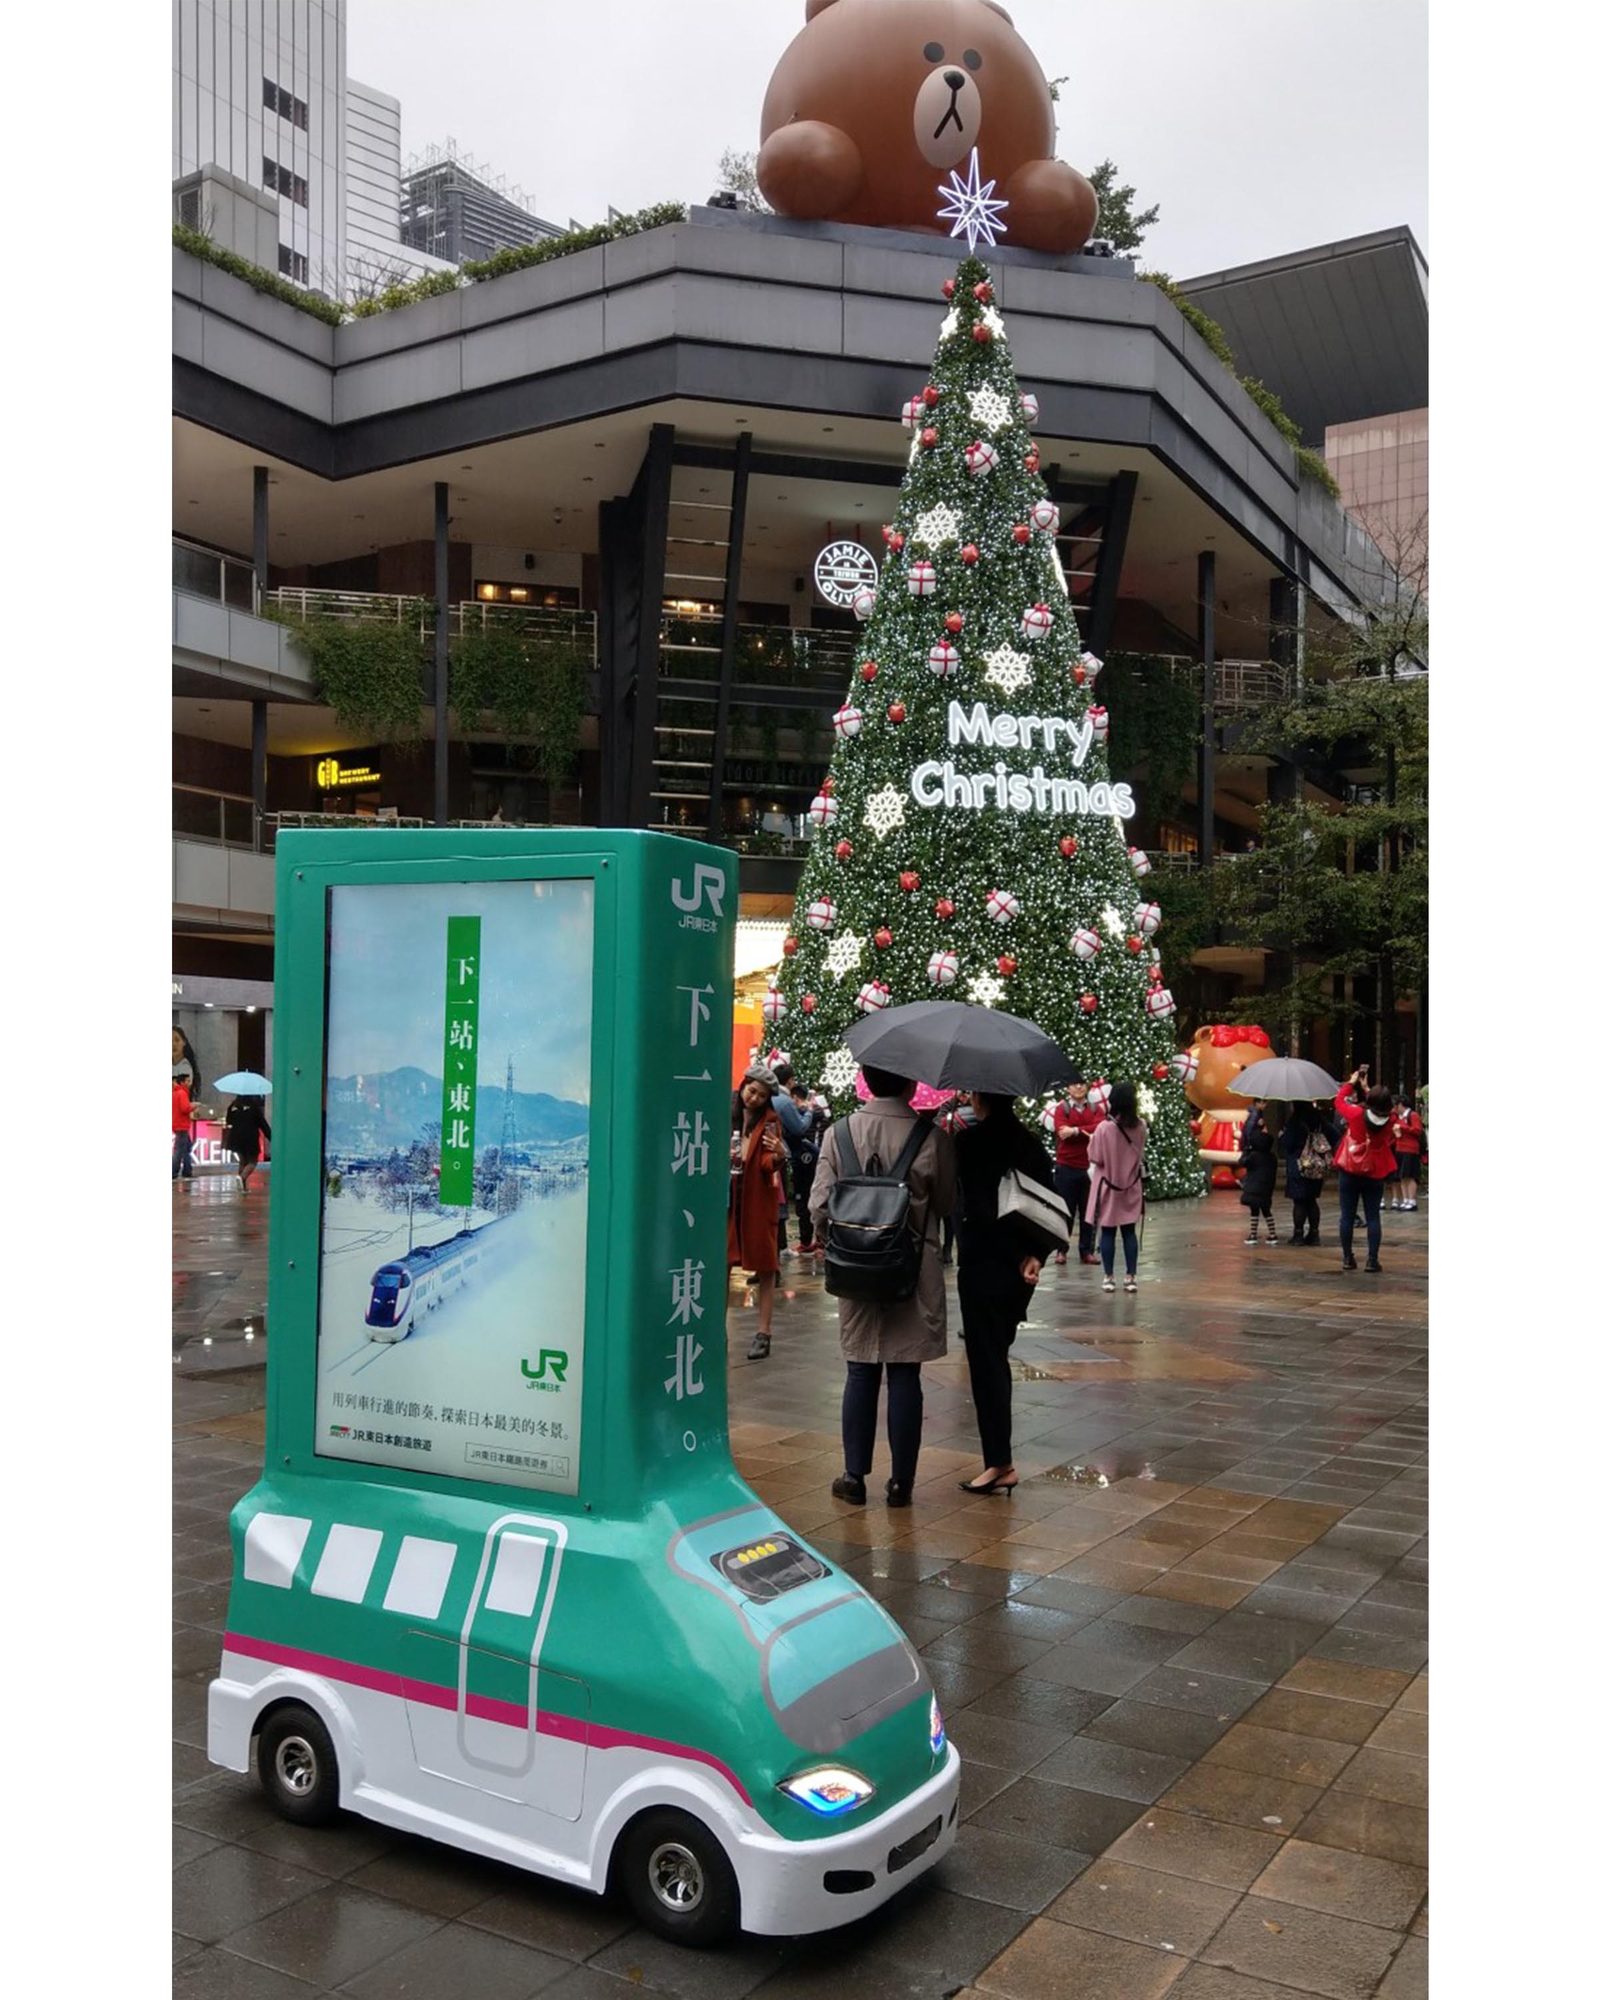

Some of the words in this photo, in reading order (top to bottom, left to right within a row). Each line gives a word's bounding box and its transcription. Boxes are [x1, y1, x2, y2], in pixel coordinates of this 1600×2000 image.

[825, 545, 869, 565] JAMIE
[822, 580, 869, 604] OLIV
[948, 699, 1094, 767] Merry
[911, 760, 1136, 819] Christmas
[671, 863, 725, 917] JR
[447, 956, 475, 1170] 下一站、東北。
[664, 983, 715, 1452] 下一站、東北。
[521, 1349, 568, 1382] JR
